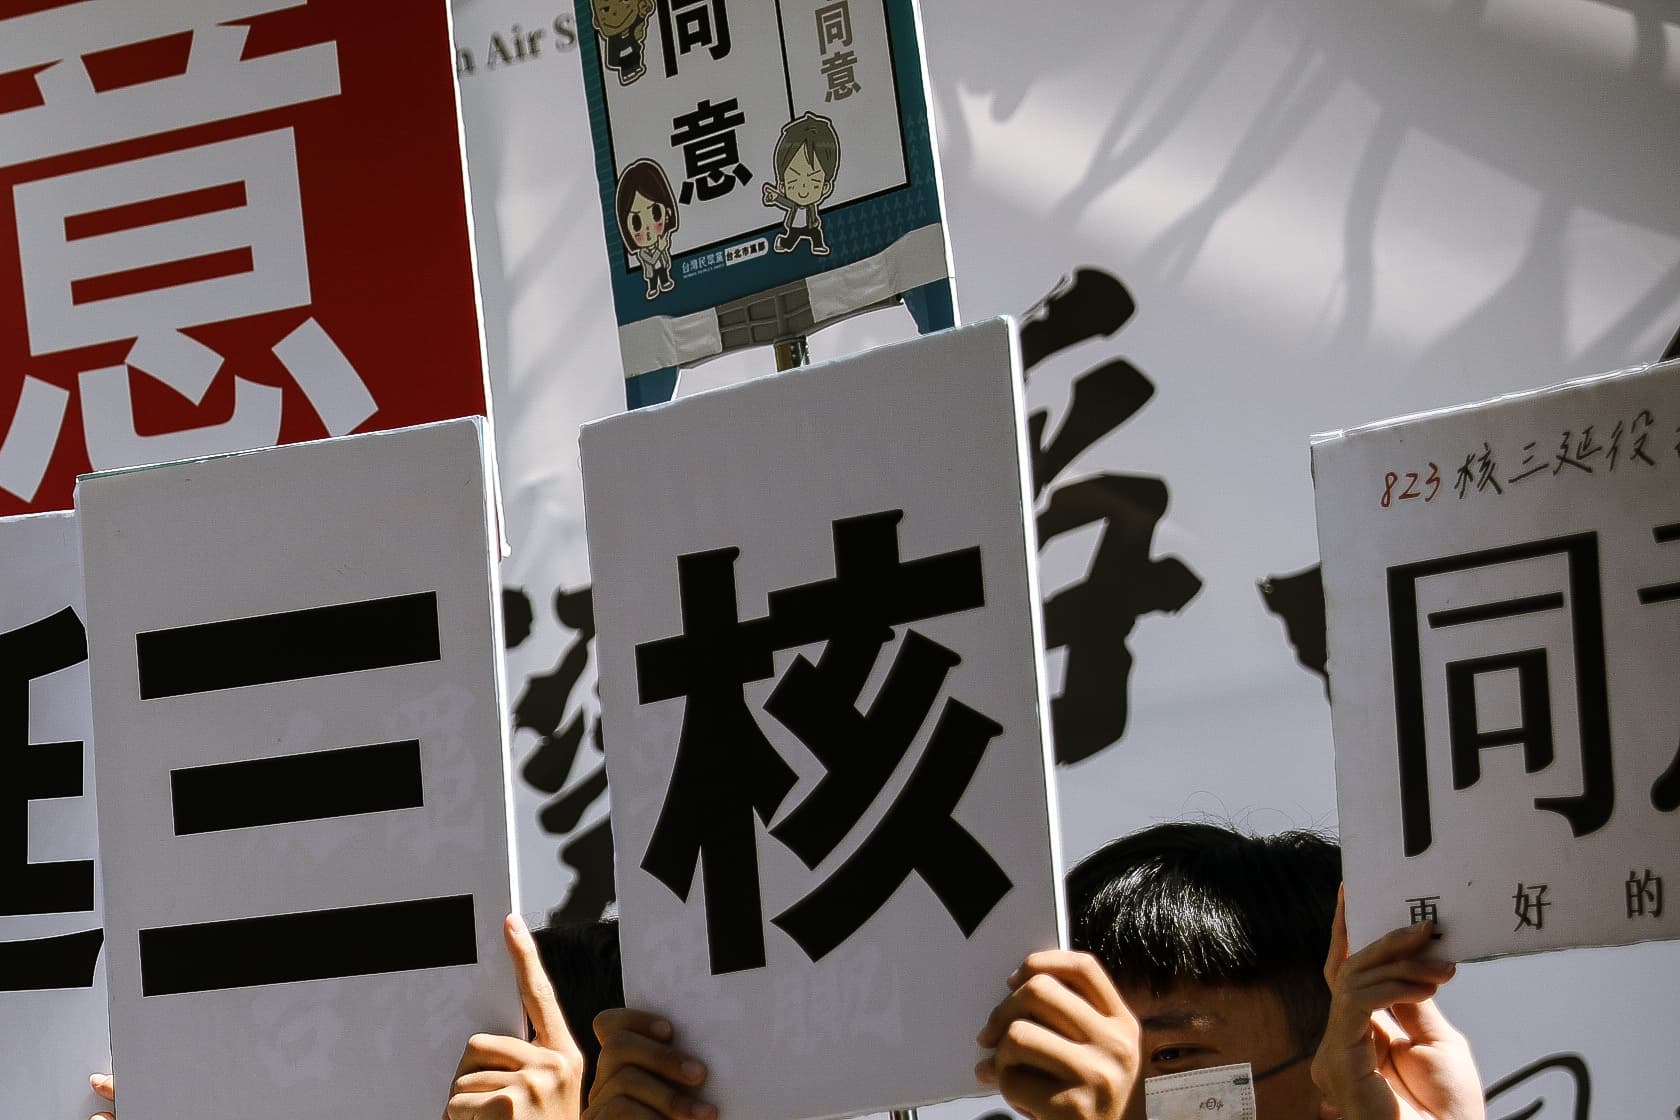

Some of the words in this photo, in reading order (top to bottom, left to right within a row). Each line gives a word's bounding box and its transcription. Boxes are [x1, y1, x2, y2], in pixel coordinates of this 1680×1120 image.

[486, 24, 546, 71] Air
[656, 0, 753, 205] 同意
[814, 0, 862, 103] 同意
[1380, 462, 1441, 508] 823
[1454, 409, 1680, 499] 核三延役
[635, 508, 1015, 976] 核
[1387, 523, 1680, 857] 同
[136, 590, 478, 997] 三
